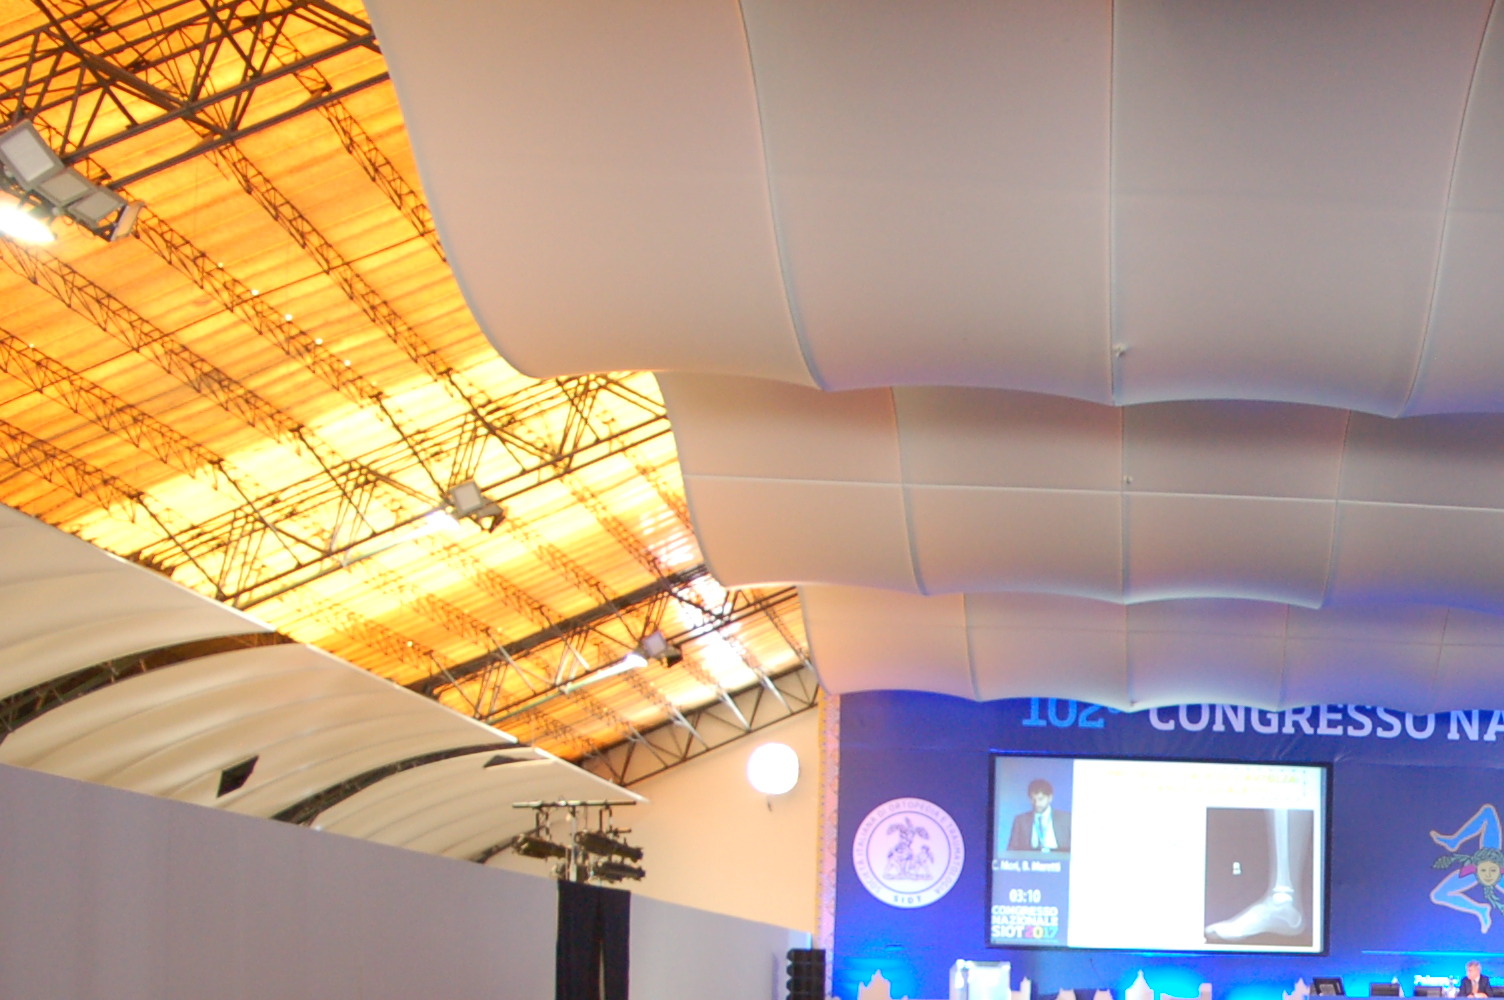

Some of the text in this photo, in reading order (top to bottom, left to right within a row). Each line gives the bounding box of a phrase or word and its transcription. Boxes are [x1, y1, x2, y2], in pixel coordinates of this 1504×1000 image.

[1149, 703, 1436, 740] CONGRESSO
[894, 895, 922, 905] SIOT
[1009, 889, 1041, 904] 03:10
[991, 905, 1059, 916] CONGRESSO
[991, 915, 1059, 926] NAZIONALE
